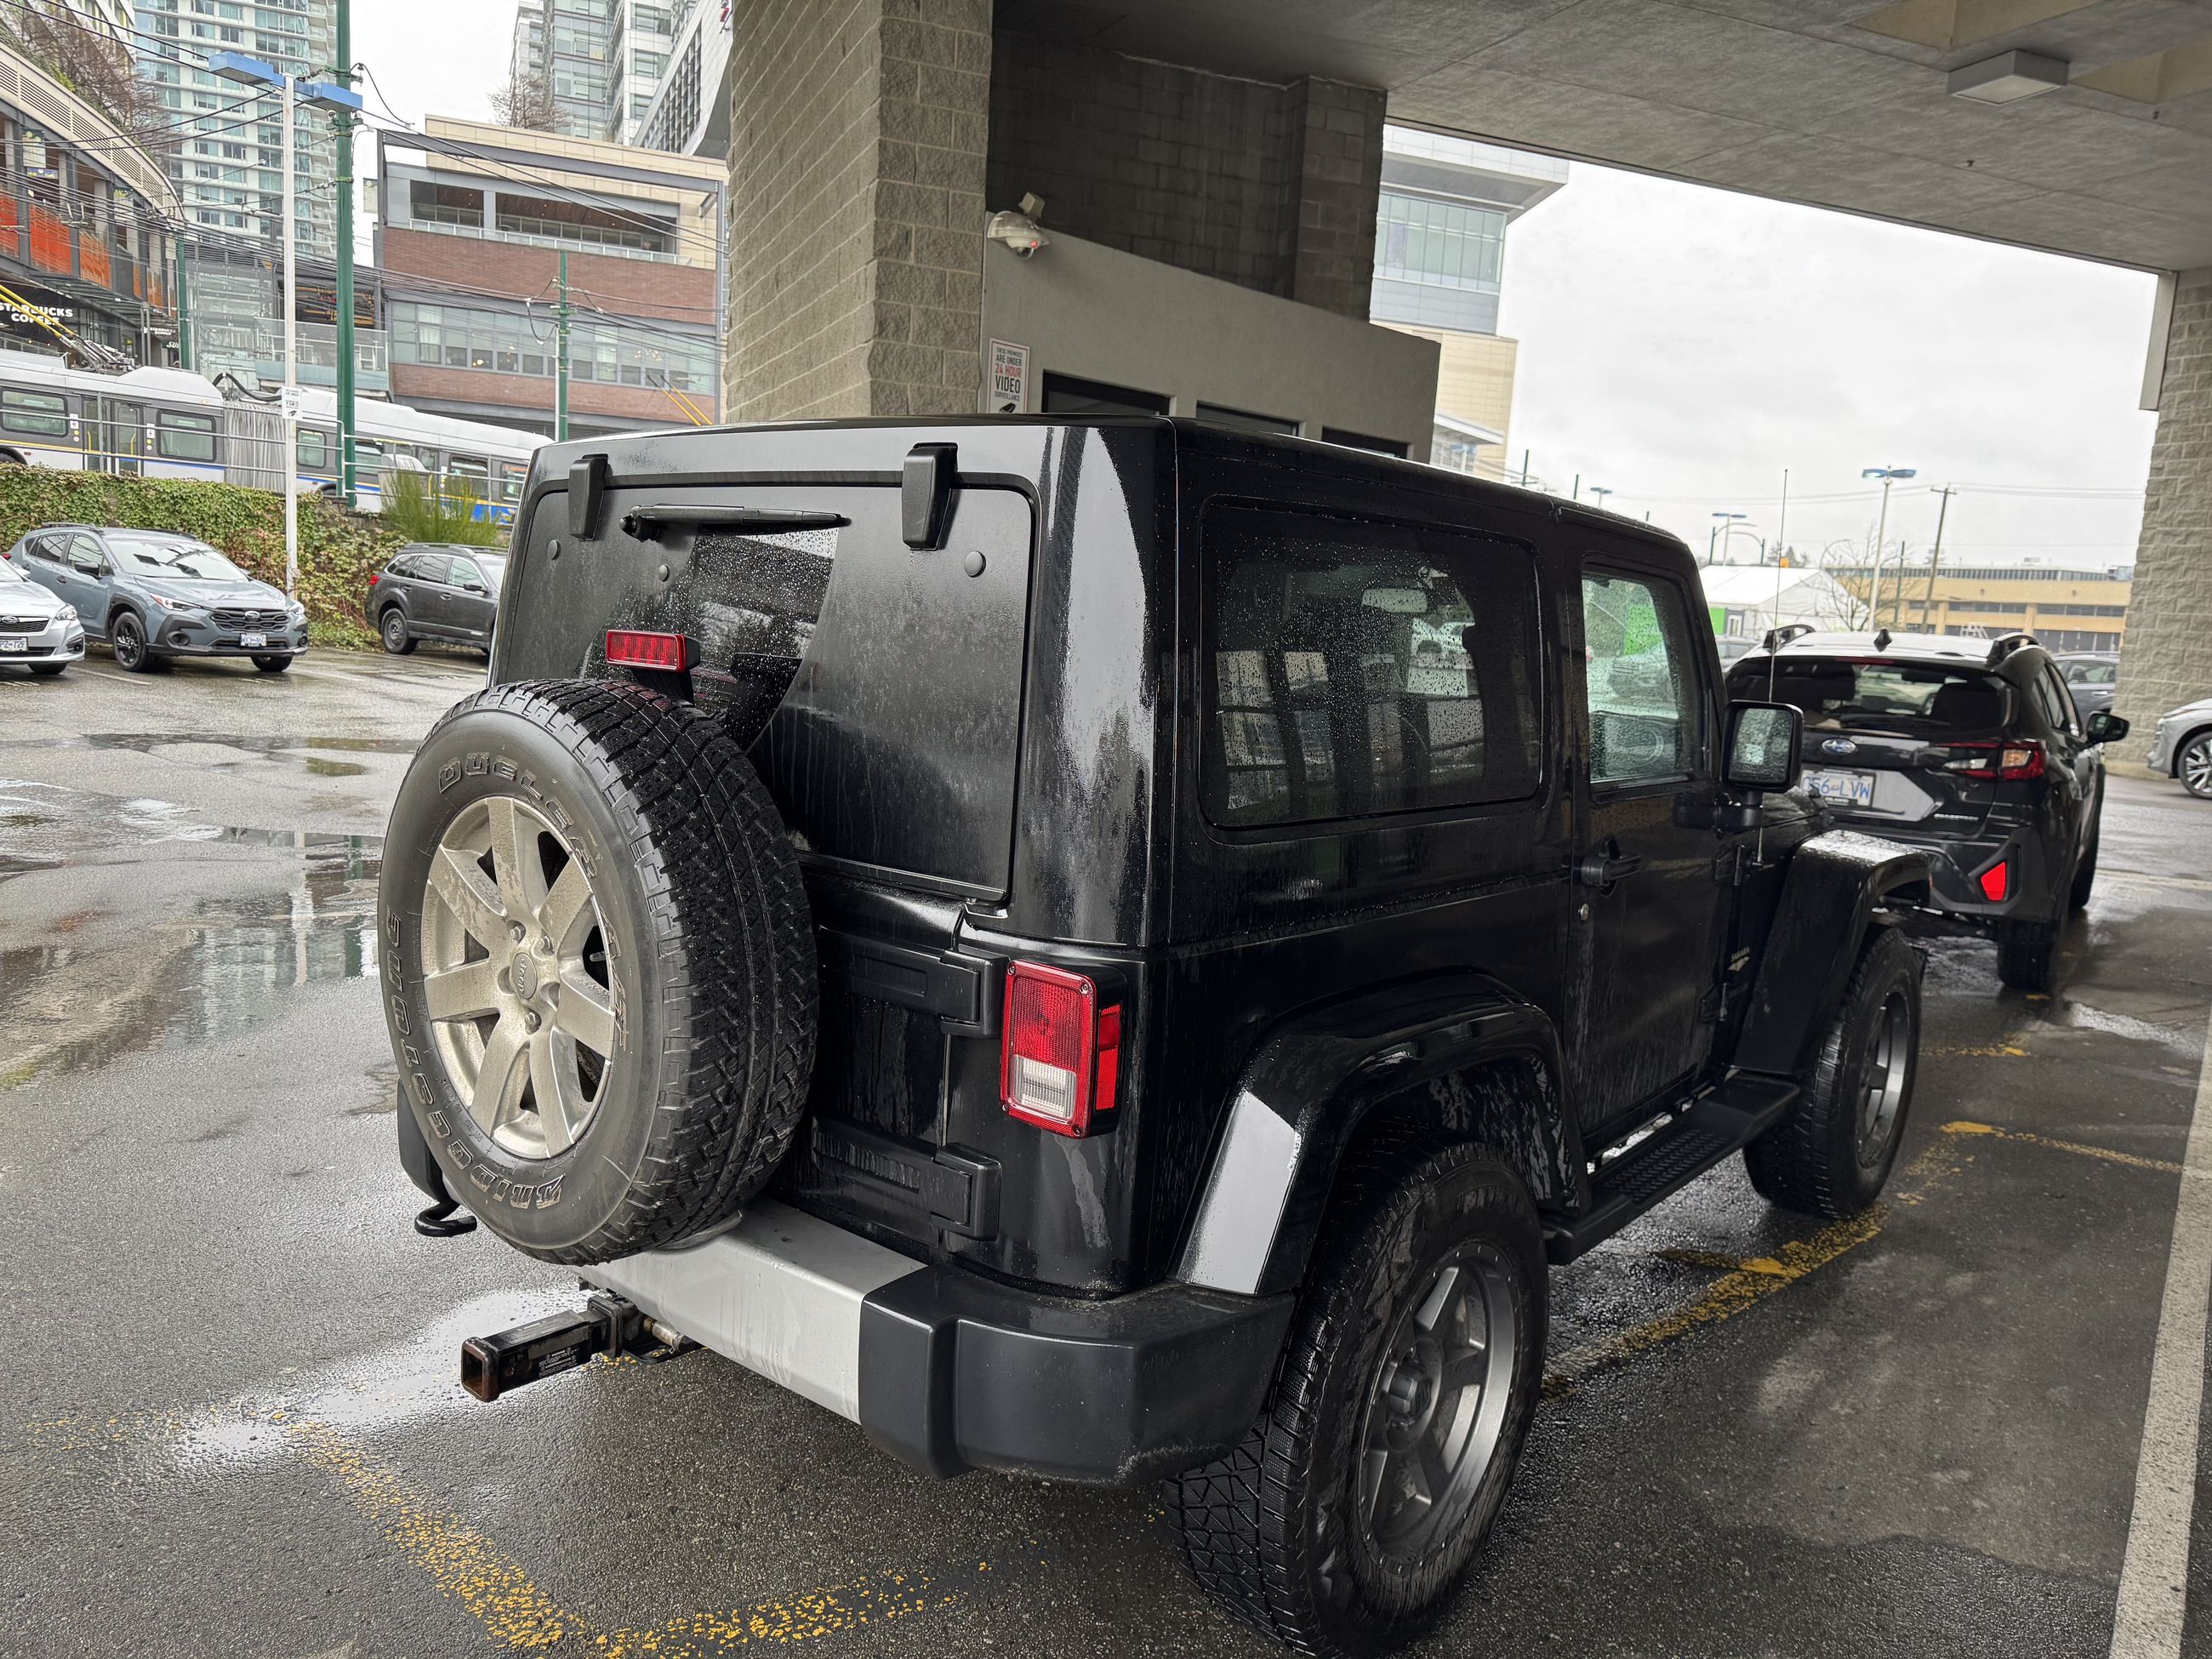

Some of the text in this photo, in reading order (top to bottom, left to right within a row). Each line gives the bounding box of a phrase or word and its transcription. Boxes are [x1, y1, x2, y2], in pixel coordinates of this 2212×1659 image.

[0, 302, 74, 318] STARBUCKS
[995, 362, 1021, 378] 24 HOUR
[996, 354, 1022, 366] ARE UNDER
[995, 374, 1021, 394] VIDEO
[439, 752, 598, 879] DUELER
[517, 958, 527, 994] Jeep
[386, 904, 566, 1210] BRIDGESTONE
